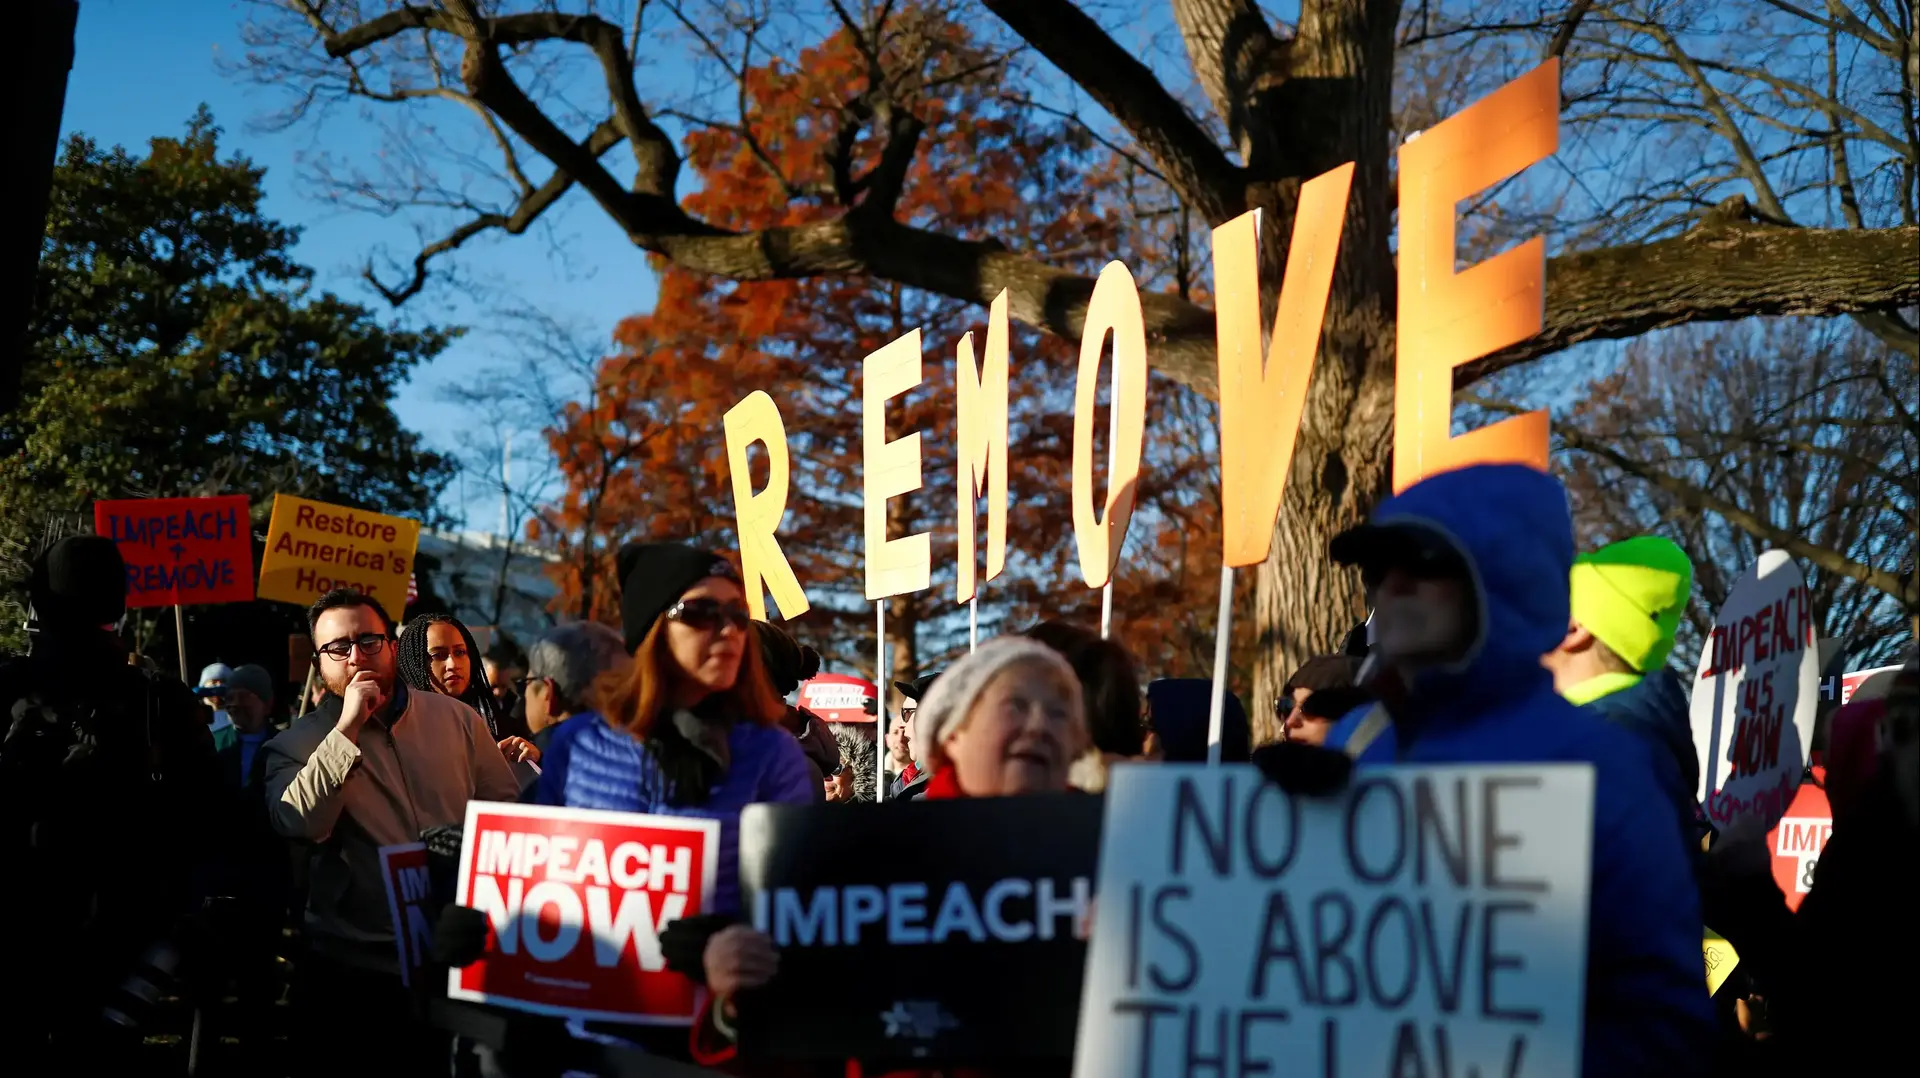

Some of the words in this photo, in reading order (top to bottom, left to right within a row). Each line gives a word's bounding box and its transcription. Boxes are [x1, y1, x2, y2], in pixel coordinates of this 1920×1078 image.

[723, 57, 1560, 620] REMOVE
[109, 507, 237, 548] IMPEACH
[274, 531, 407, 575] America's
[296, 505, 396, 543] Restore
[125, 557, 234, 594] REMOVE
[1702, 585, 1812, 680] IMPEACH
[1731, 703, 1785, 780] NOW
[476, 829, 692, 892] IMPEACH
[1171, 775, 1299, 879] NO
[1345, 776, 1550, 893] ONE
[473, 873, 688, 972] NOW
[755, 877, 1090, 946] IMPEACH
[1127, 880, 1198, 994] IS
[1249, 889, 1544, 1024] ABOVE
[1113, 999, 1291, 1078] THE
